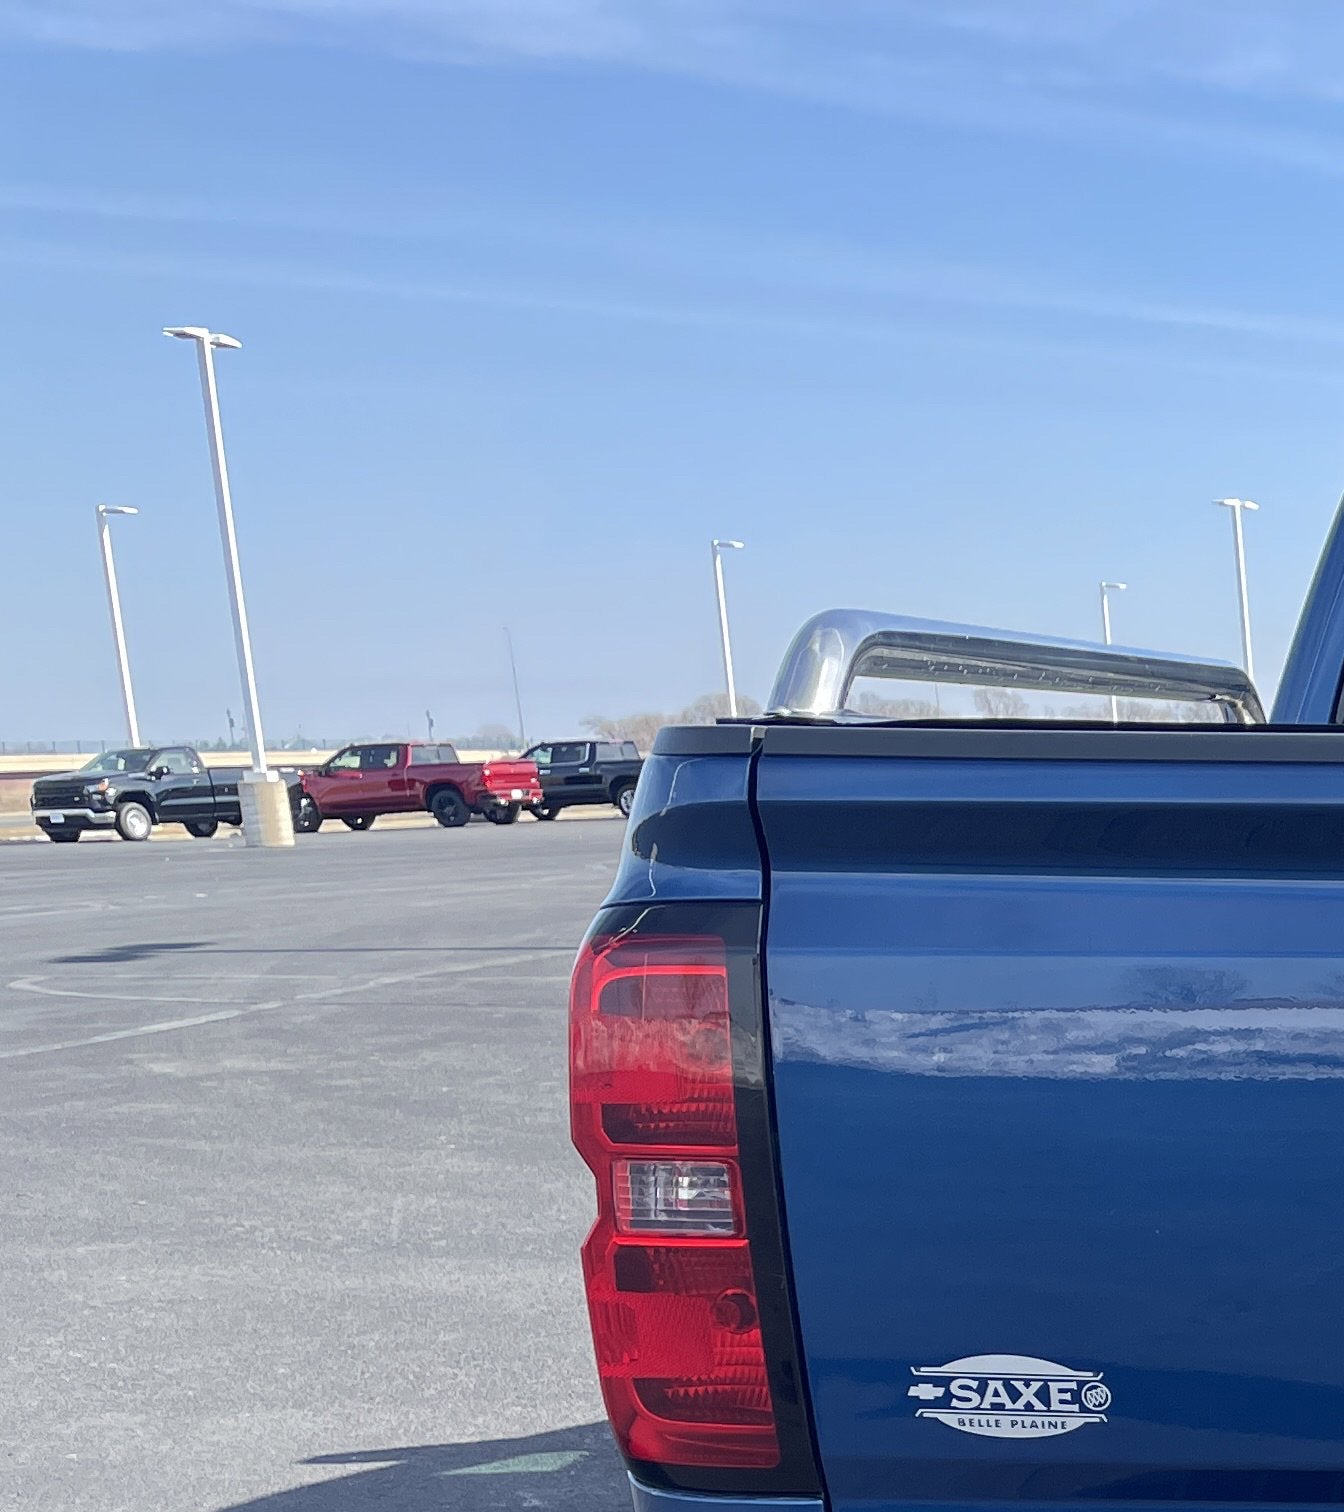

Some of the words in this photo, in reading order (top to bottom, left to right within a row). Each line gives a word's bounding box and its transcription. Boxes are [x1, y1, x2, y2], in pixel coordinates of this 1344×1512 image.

[949, 1378, 1080, 1413] SAXE
[957, 1416, 1002, 1429] BELLE
[1010, 1417, 1068, 1430] PLAINE
